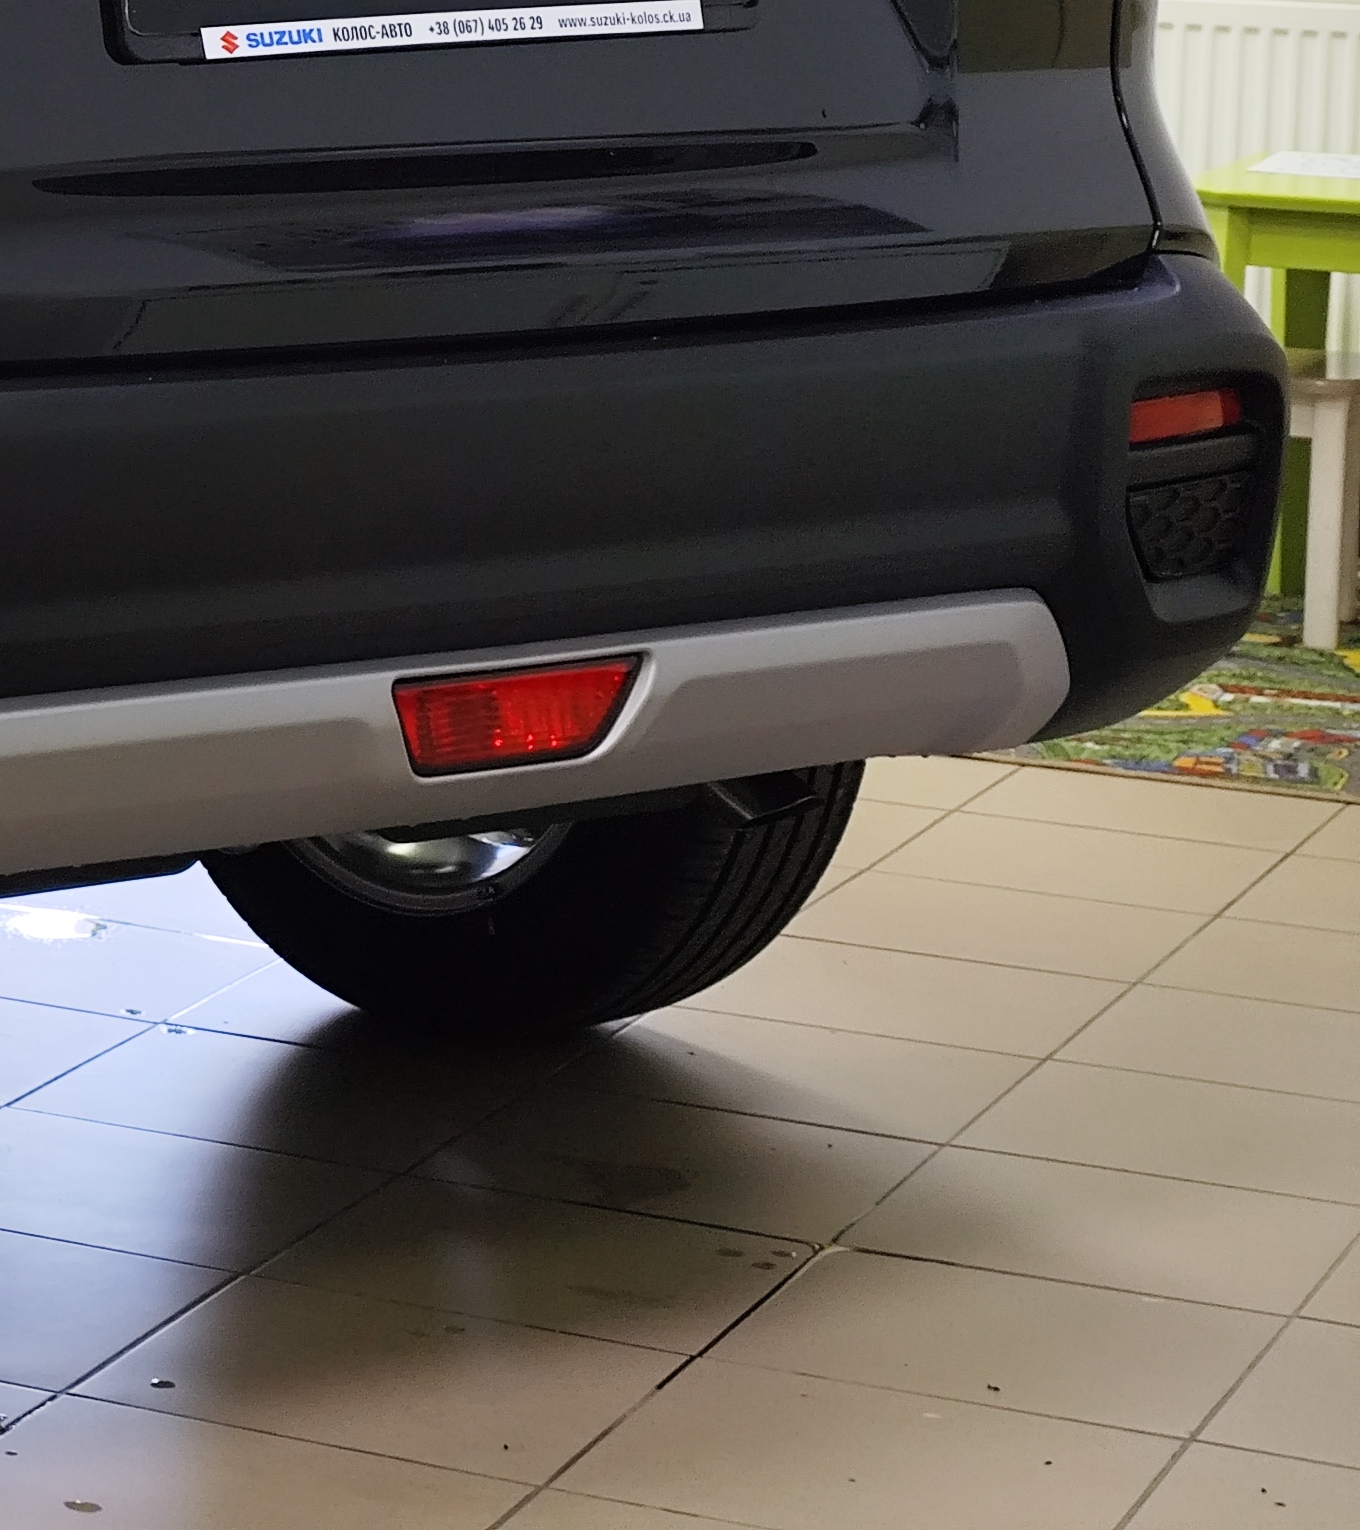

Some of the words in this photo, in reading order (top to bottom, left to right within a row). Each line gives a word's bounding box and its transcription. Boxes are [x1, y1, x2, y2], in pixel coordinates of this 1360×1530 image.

[332, 22, 413, 42] КОЛОС-АВТО
[428, 20, 450, 36] +38
[453, 16, 485, 38] (067)
[488, 17, 509, 33] 405
[513, 16, 527, 32] 26
[529, 15, 544, 31] 29
[558, 10, 692, 29] www.suzuki-kolos.ck.ua
[246, 27, 324, 49] SUZUKI
